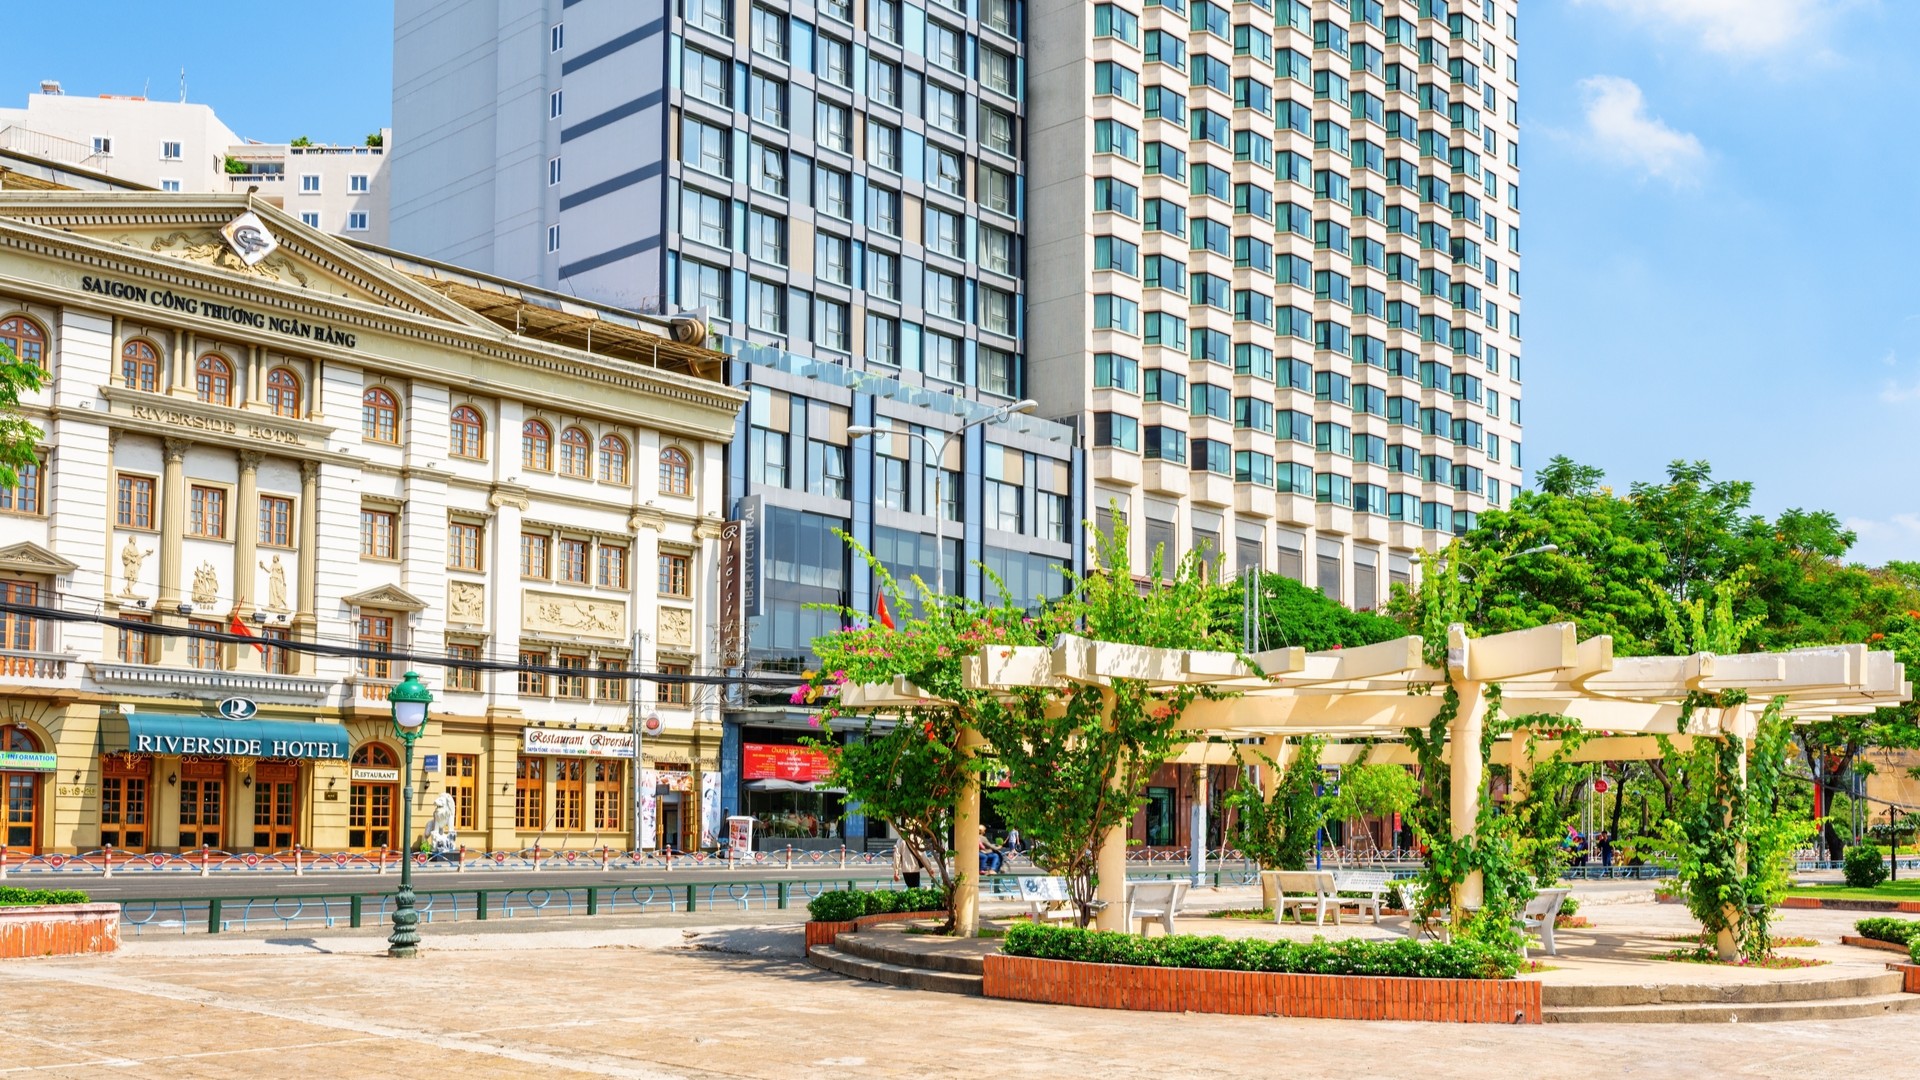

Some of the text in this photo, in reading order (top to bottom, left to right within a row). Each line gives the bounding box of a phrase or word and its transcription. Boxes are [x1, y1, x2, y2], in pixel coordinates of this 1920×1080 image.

[82, 276, 147, 303] SAIGON
[150, 290, 198, 314] CÔNG
[268, 316, 312, 338] NGÂN
[314, 325, 356, 348] HÀNG
[132, 404, 307, 447] RIVERSIDE HOTEL
[744, 504, 755, 608] LIBERTY CENTRAL
[137, 734, 344, 758] RIVERSIDE HOTEL
[529, 730, 634, 748] Restaurant Riverside
[7, 753, 55, 762] INFORMATION
